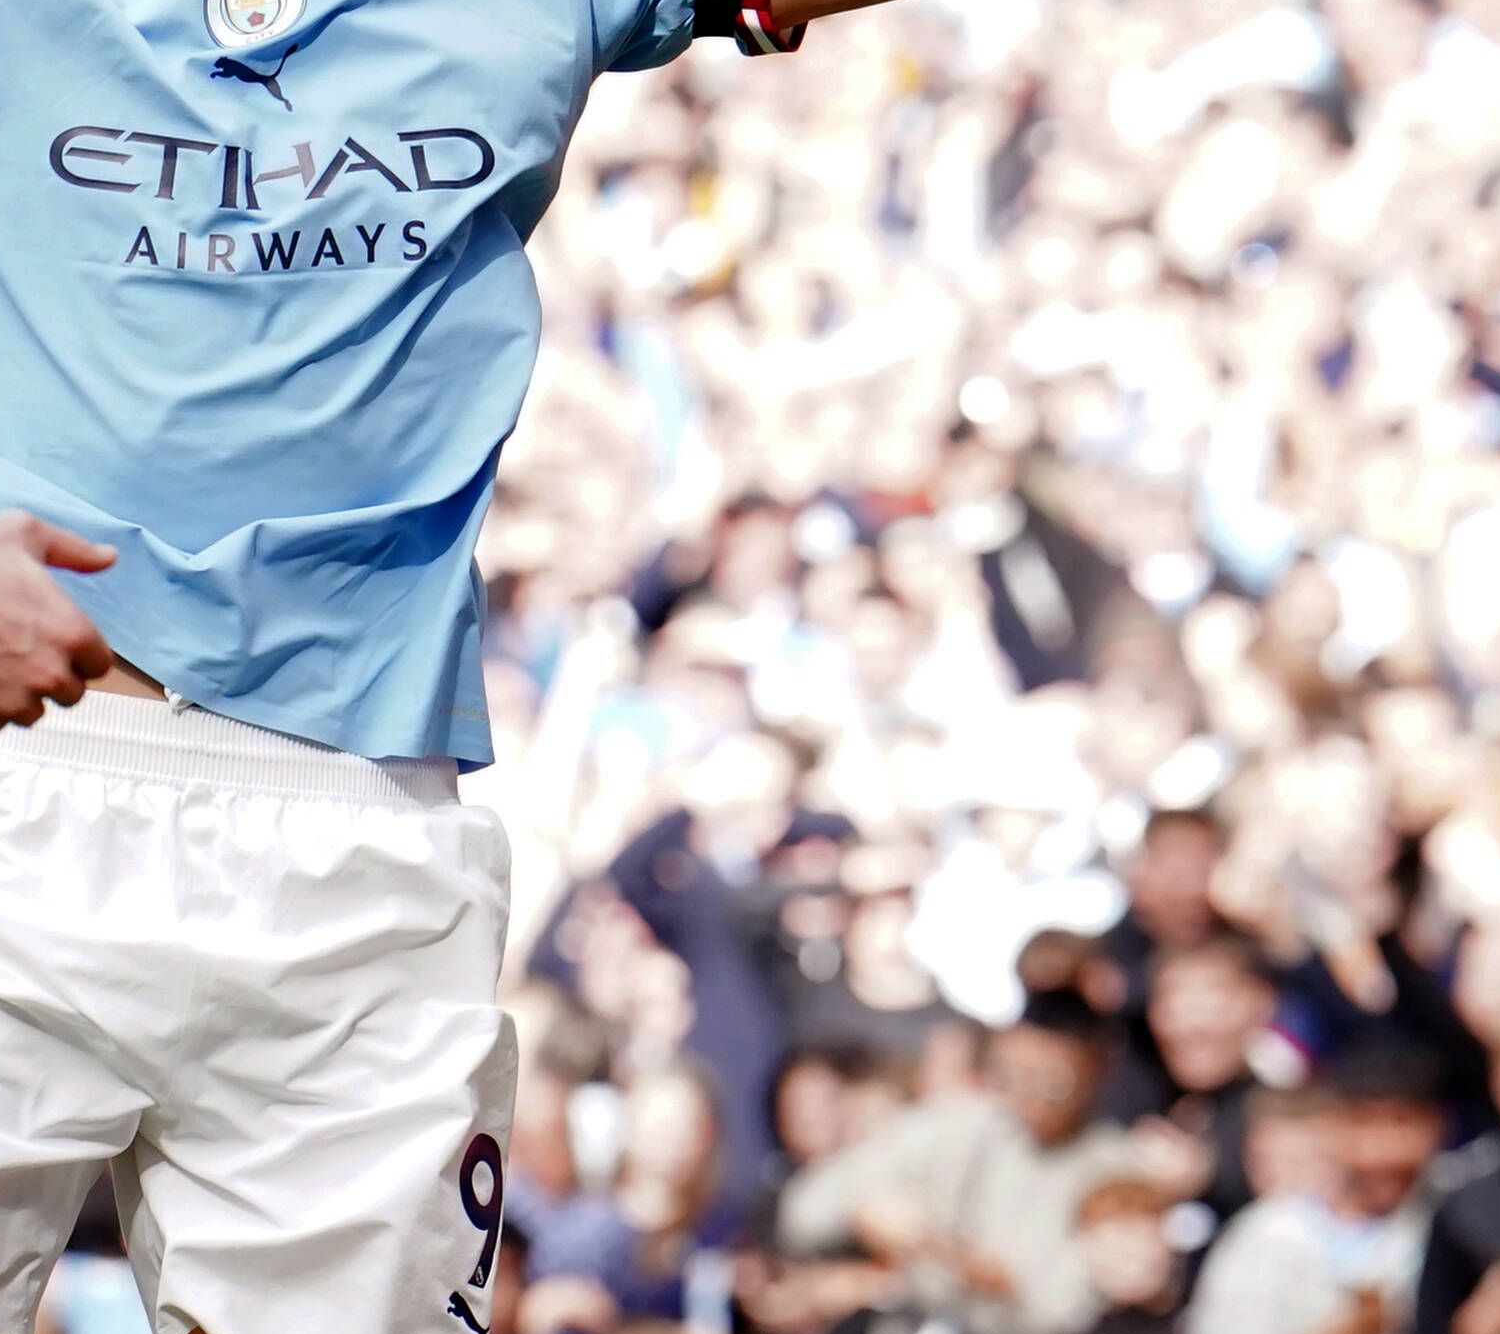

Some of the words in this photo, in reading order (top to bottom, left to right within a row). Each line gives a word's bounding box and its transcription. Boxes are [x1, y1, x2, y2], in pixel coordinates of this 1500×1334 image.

[48, 125, 497, 212] ETIHAD
[124, 219, 429, 273] AIRWAYS
[459, 1132, 504, 1289] 9
